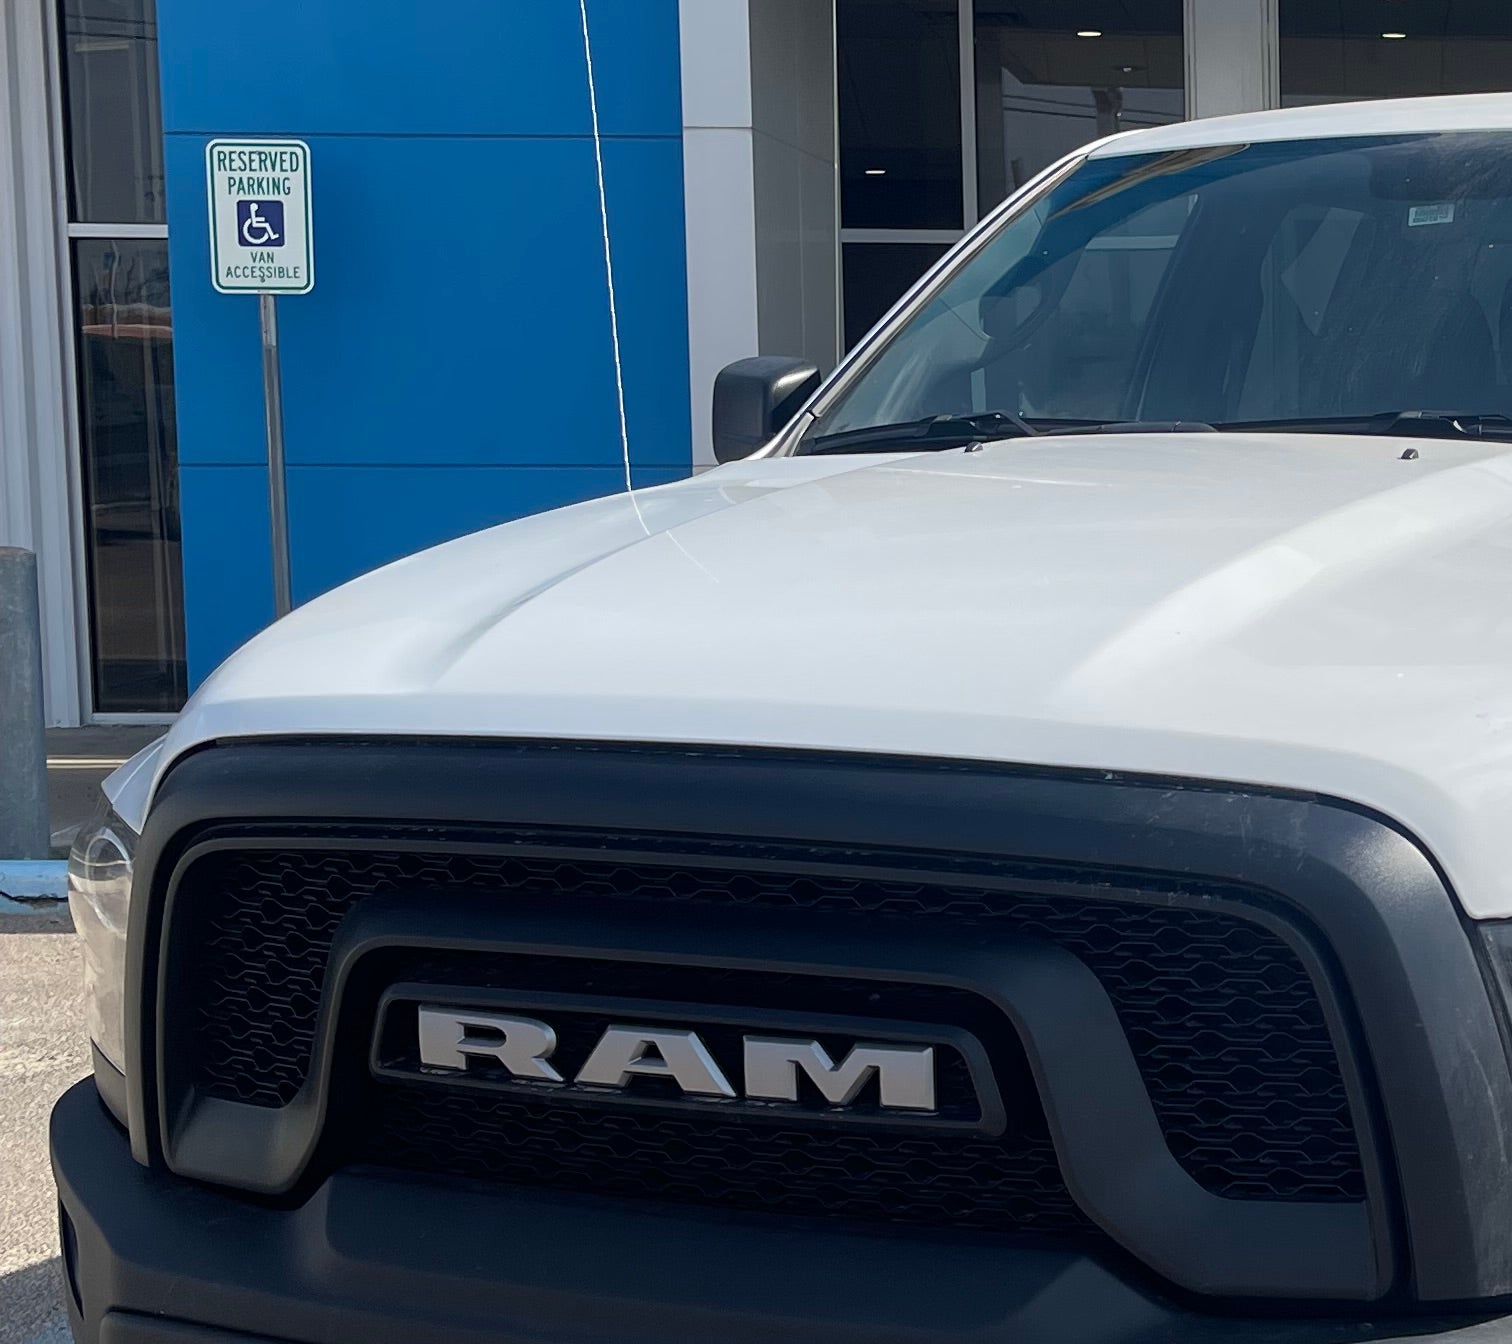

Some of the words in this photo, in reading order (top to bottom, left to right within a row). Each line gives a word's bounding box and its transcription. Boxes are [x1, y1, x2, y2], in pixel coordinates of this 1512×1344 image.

[217, 150, 299, 172] RESERVED
[228, 176, 291, 195] PARKING
[250, 251, 275, 264] VAN
[226, 266, 300, 279] ACCESSIBLE
[417, 1003, 937, 1112] RAM
